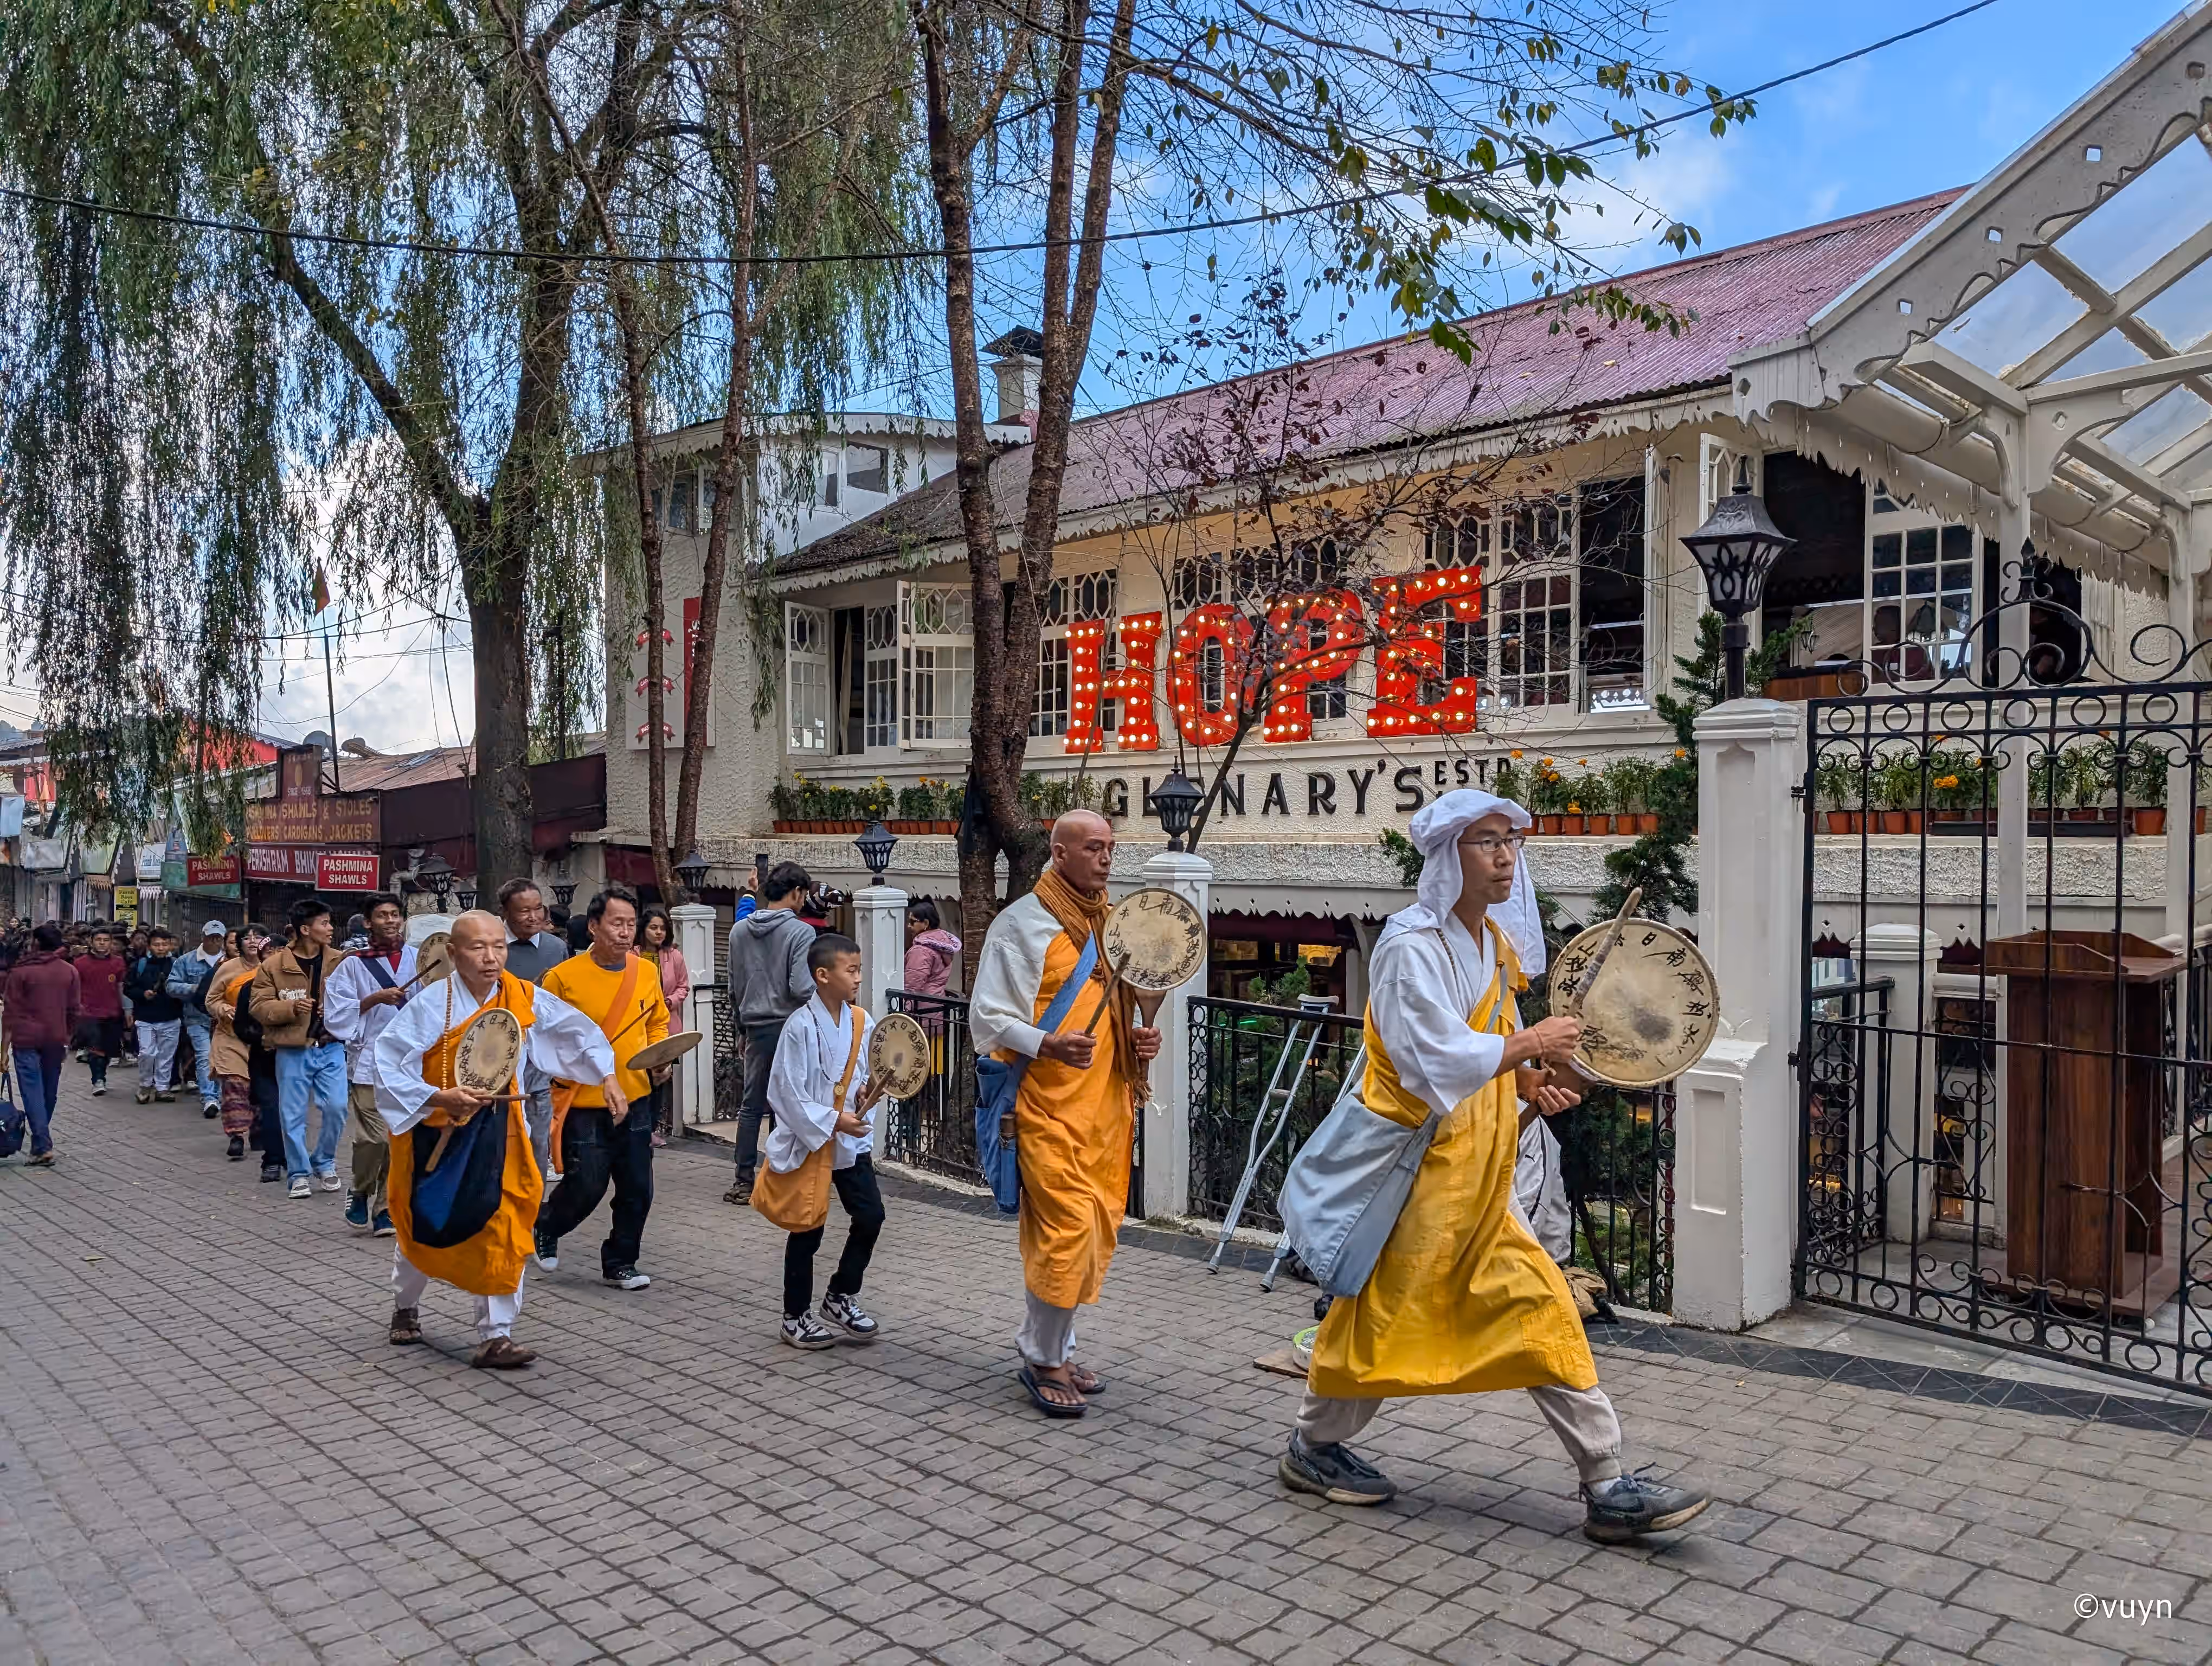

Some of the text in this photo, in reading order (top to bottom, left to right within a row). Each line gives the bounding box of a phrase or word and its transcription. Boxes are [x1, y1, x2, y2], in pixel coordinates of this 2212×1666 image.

[1064, 566, 1482, 754] HOPE
[282, 801, 317, 818] SHAWLS
[323, 800, 329, 820] &
[335, 800, 372, 817] STOLES
[330, 822, 372, 840] JACKETS
[248, 848, 289, 873] PERASHRAM
[324, 859, 373, 872] PASHMINA
[198, 872, 231, 881] SHAWLS
[329, 874, 367, 885] SHAWLS
